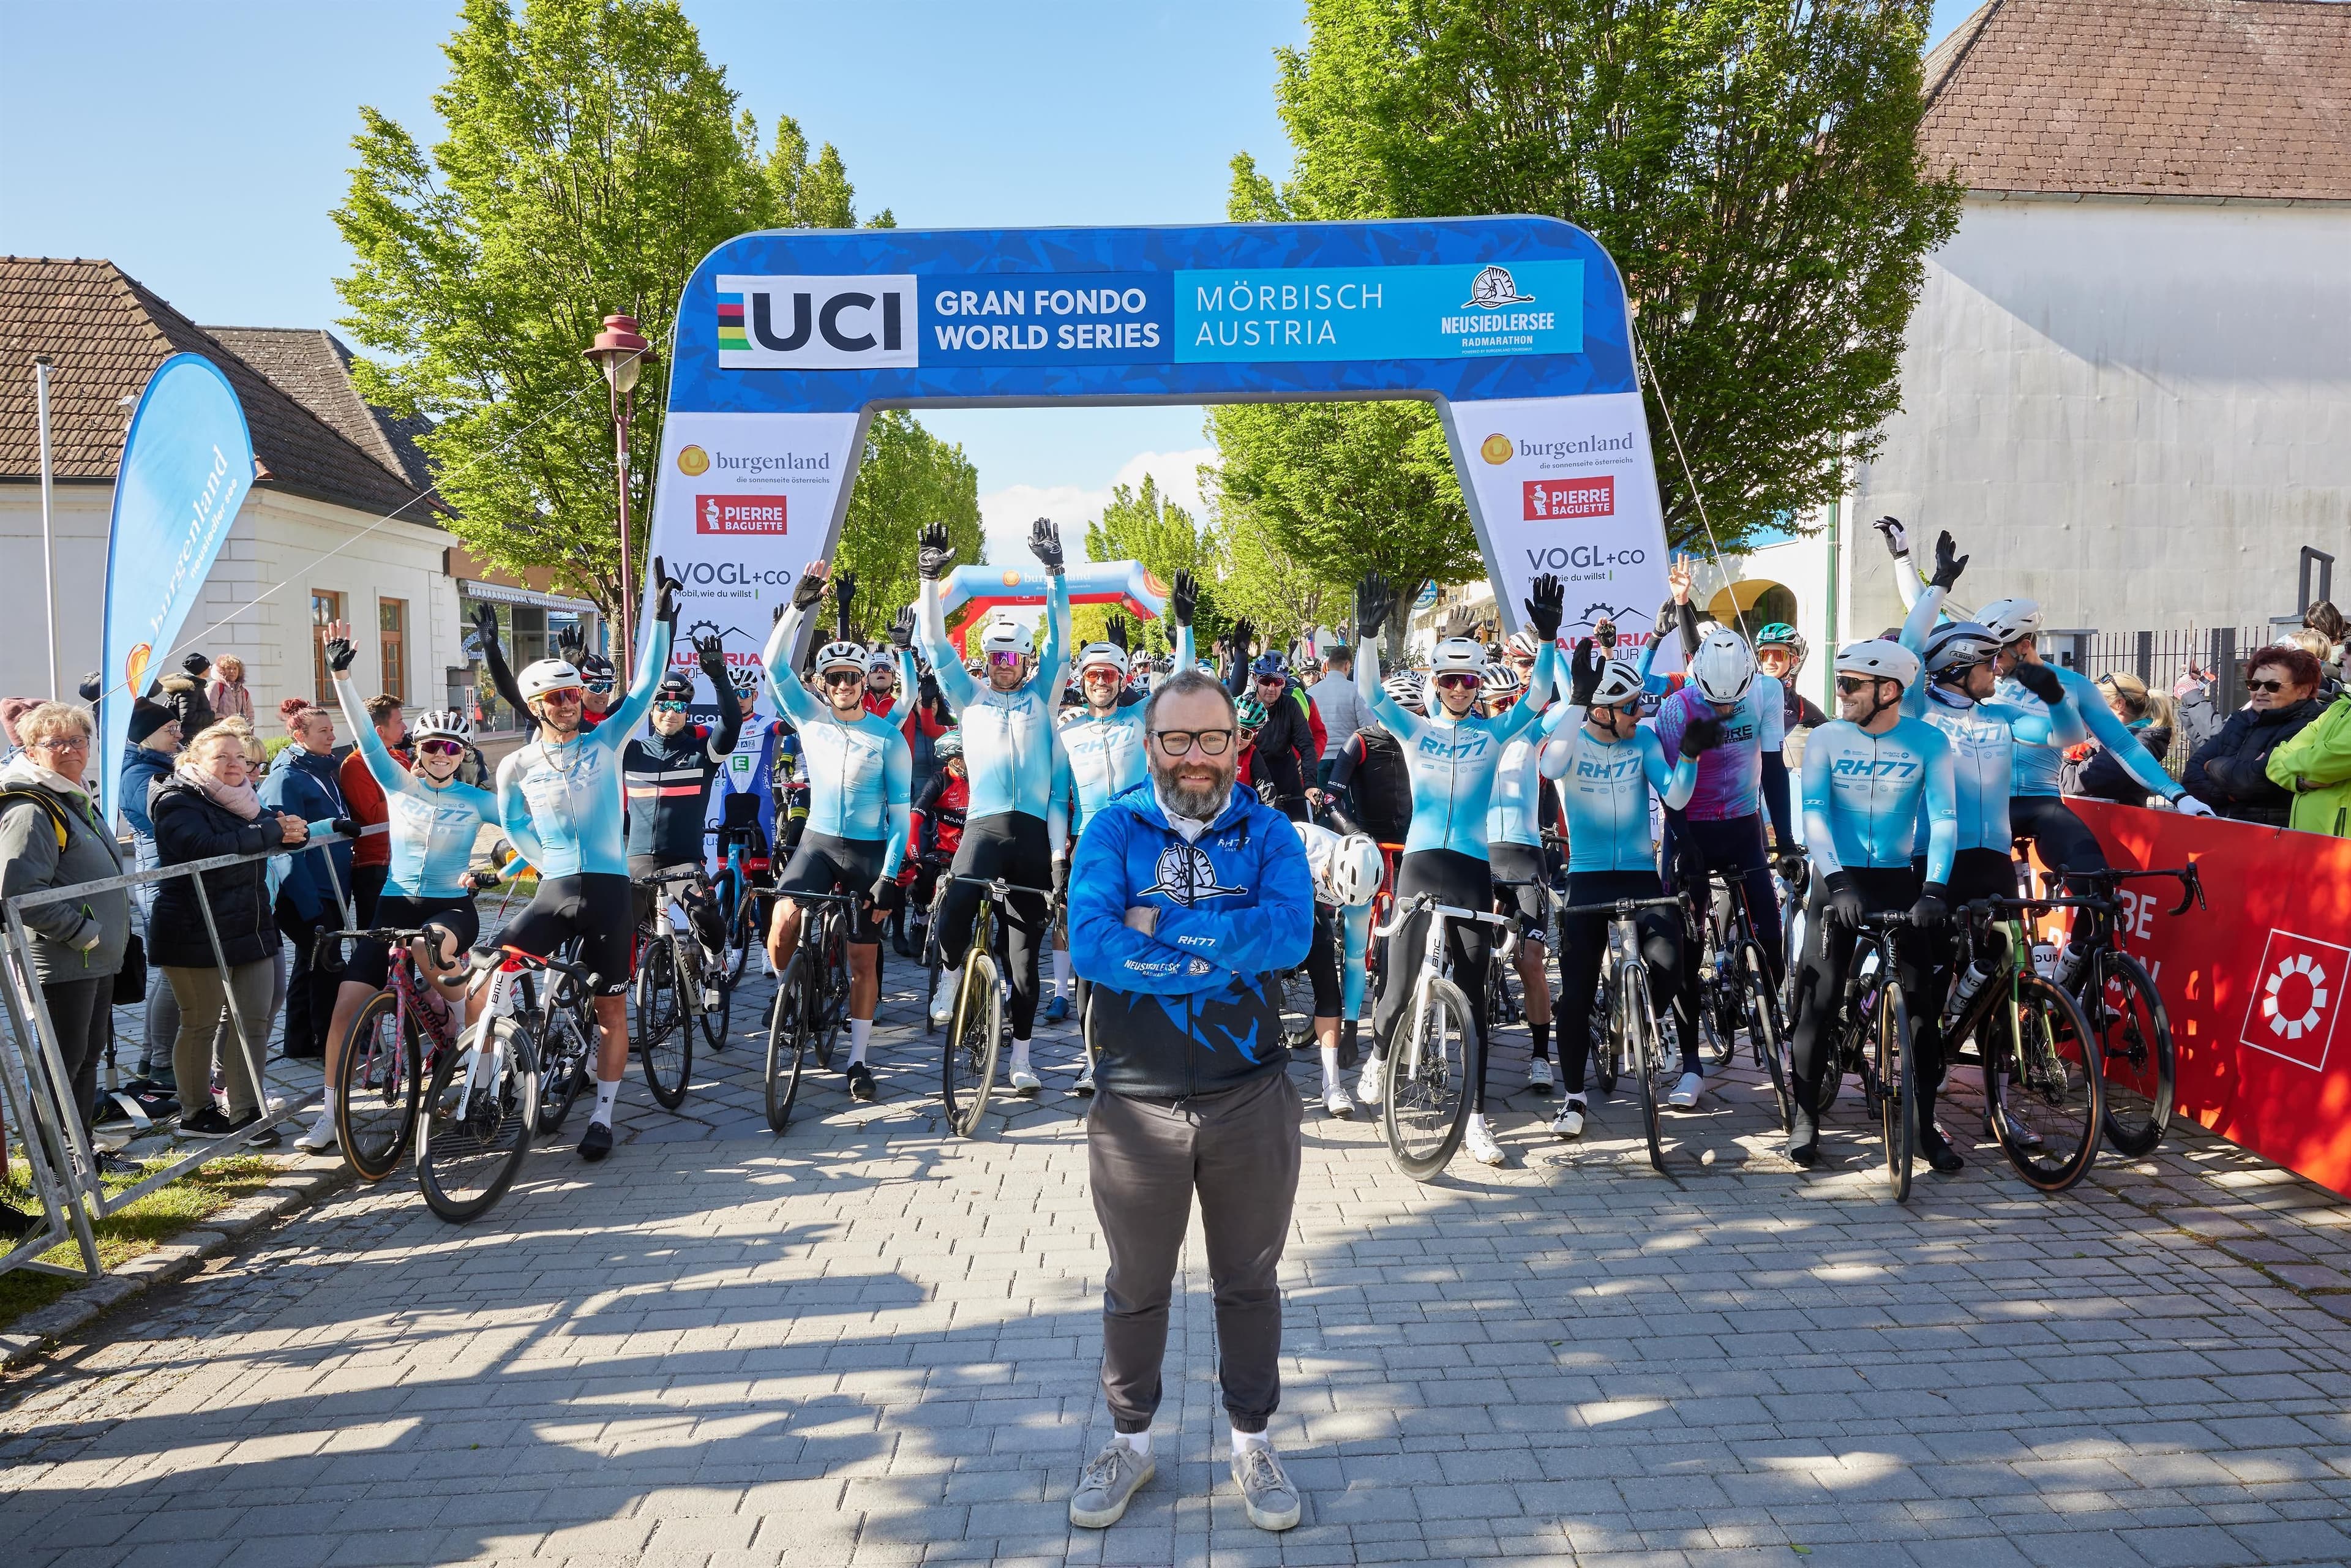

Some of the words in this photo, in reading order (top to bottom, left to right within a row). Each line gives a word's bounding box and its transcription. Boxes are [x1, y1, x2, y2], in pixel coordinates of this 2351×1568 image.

[934, 289, 1026, 316] GRAN
[1035, 287, 1147, 315] FONDO
[1196, 280, 1382, 312] MÖRBISCH
[752, 291, 902, 351] UCI
[1441, 312, 1555, 334] NEUSIEDLERSEE
[934, 324, 1049, 351] WORLD
[1056, 322, 1160, 350] SERIES
[1194, 319, 1337, 347] AUSTRIA
[1461, 335, 1533, 347] RADMARATHON
[1520, 432, 1633, 460] burgenland
[716, 451, 830, 473] burgenland
[1595, 457, 1633, 465] österreichs
[1552, 487, 1610, 505] PIERRE
[725, 506, 783, 521] PIERRE
[1552, 503, 1610, 516] BAGUETTE
[190, 502, 225, 579] neusiedler
[224, 478, 238, 504] see
[725, 521, 783, 531] BAGUETTE
[151, 443, 228, 638] burgenland
[1024, 572, 1091, 585] burgland
[1952, 652, 1972, 661] ABUS
[1419, 735, 1489, 759] RH77
[1577, 756, 1642, 779] RH77
[1831, 759, 1918, 778] RH77
[1318, 892, 1334, 902] RH77
[1177, 935, 1216, 947] RH77
[1432, 938, 1441, 968] BMC
[491, 973, 504, 1005] BMC
